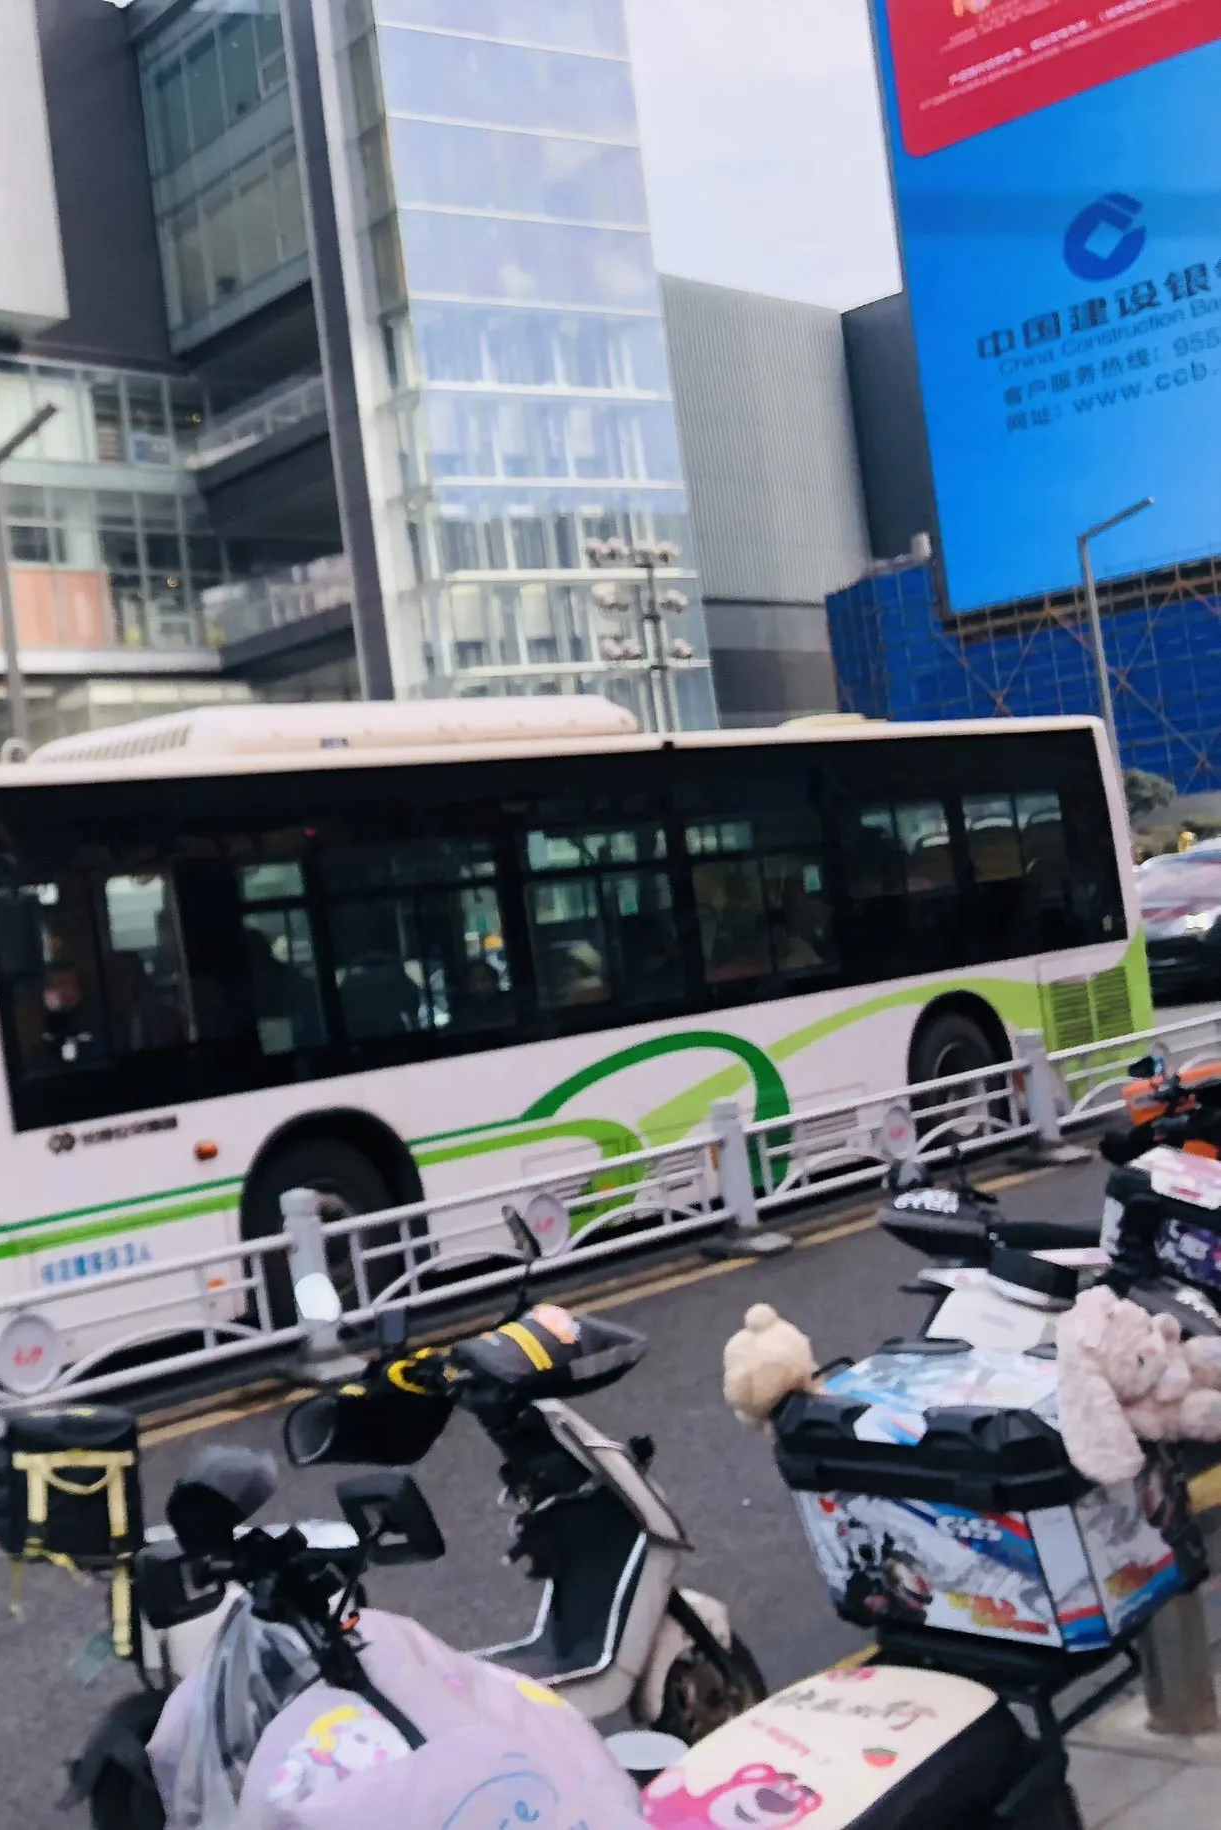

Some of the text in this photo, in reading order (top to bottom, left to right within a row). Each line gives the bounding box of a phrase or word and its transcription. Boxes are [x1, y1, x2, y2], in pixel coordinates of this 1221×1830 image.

[977, 262, 1221, 359] 中国建设银
[999, 350, 1055, 376] China
[1061, 306, 1185, 358] Construction
